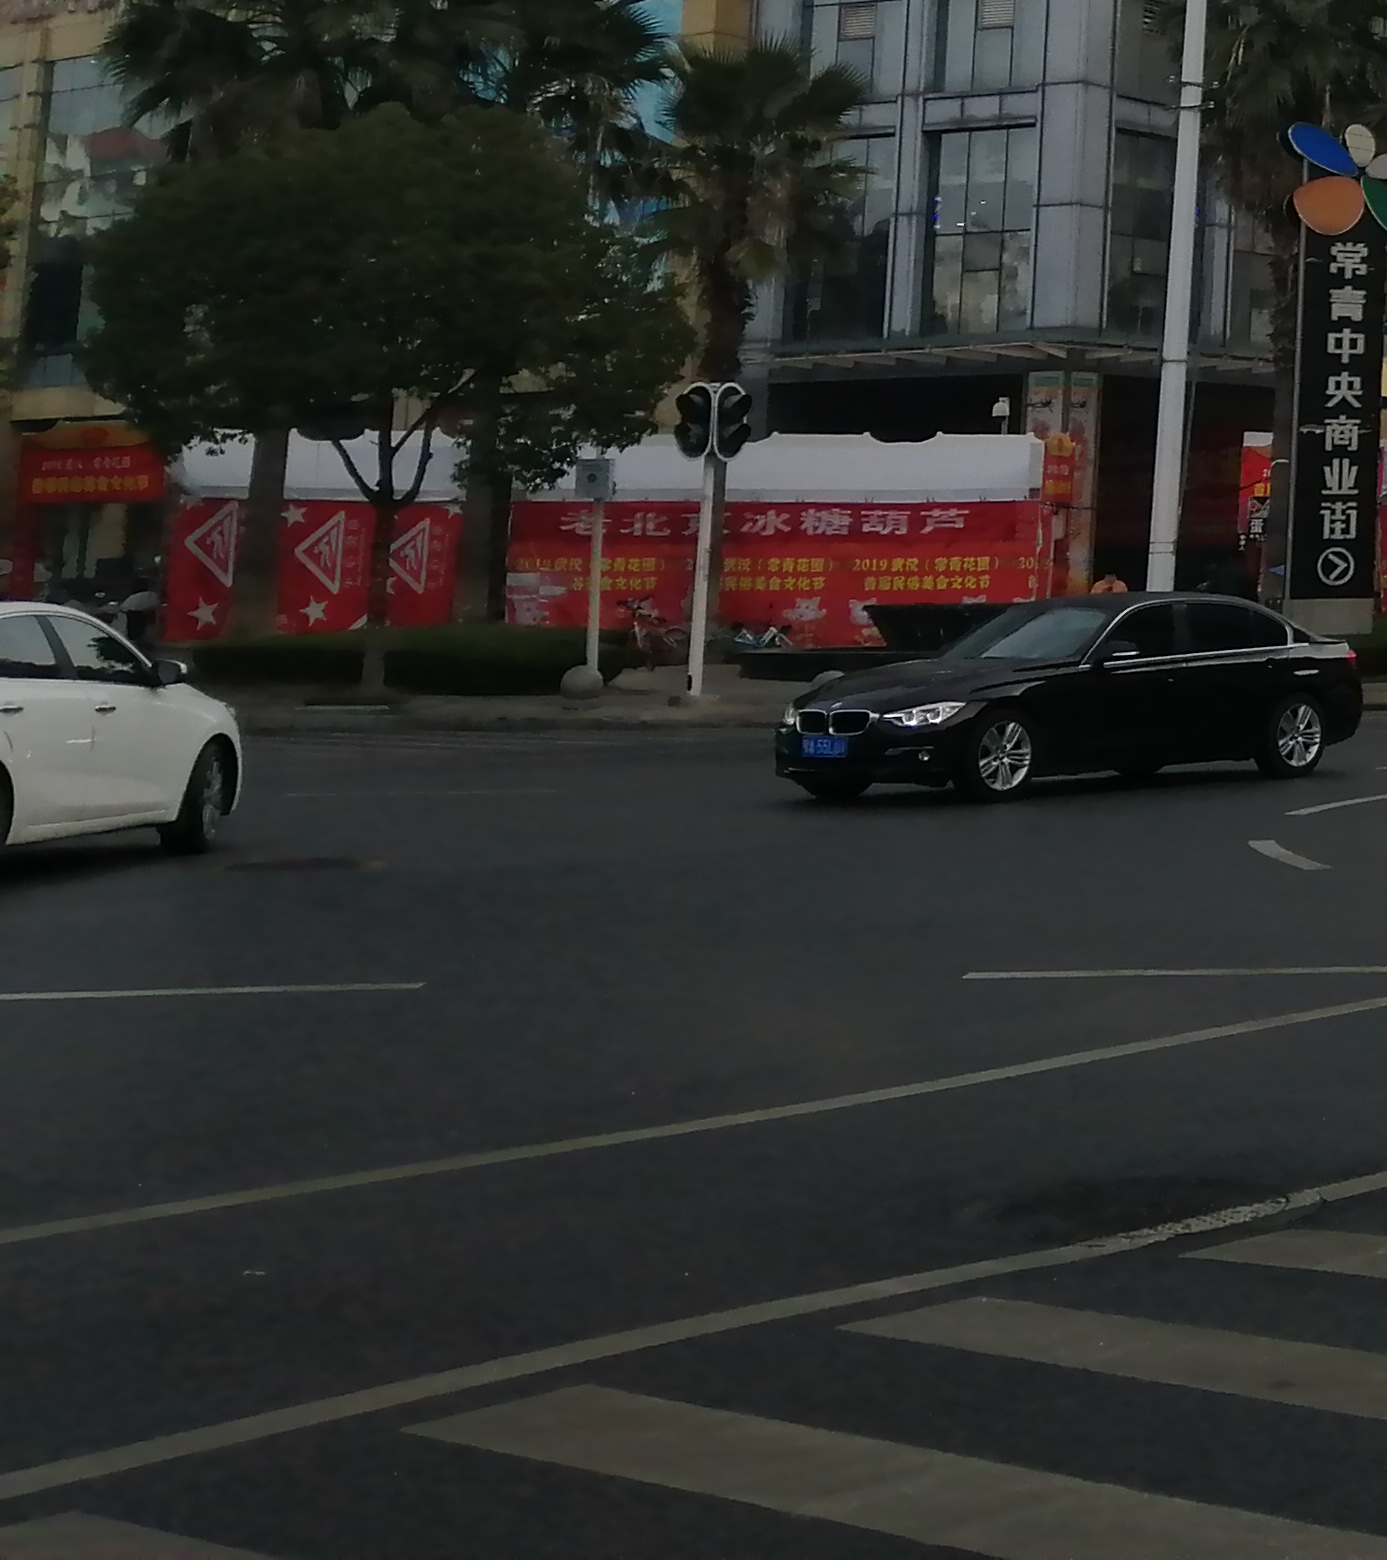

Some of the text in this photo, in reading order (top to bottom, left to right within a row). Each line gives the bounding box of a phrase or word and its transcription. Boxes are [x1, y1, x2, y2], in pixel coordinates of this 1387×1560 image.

[1319, 241, 1370, 540] 常青中央商业街
